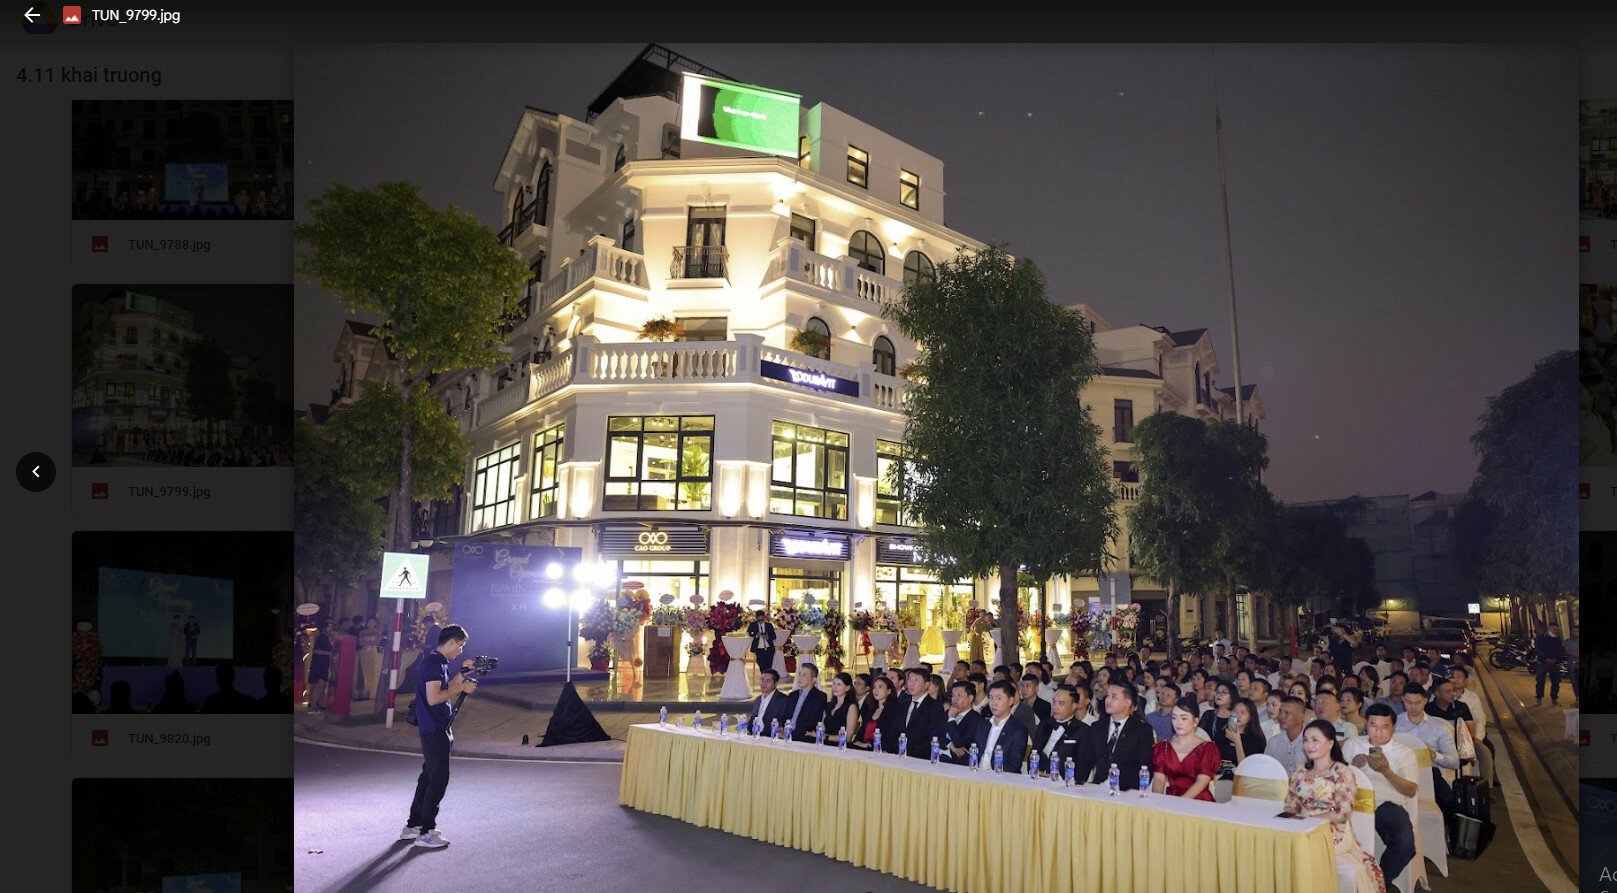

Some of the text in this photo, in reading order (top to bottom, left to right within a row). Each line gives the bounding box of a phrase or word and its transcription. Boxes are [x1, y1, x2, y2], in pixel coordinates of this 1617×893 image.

[92, 9, 181, 24] TUN_9799.jpg
[16, 66, 162, 87] 4.11 khai truong
[128, 238, 211, 253] TUN_9788.jpg
[128, 486, 211, 499] TUN_9799.jpg
[128, 733, 211, 747] TUN_9820.jpg
